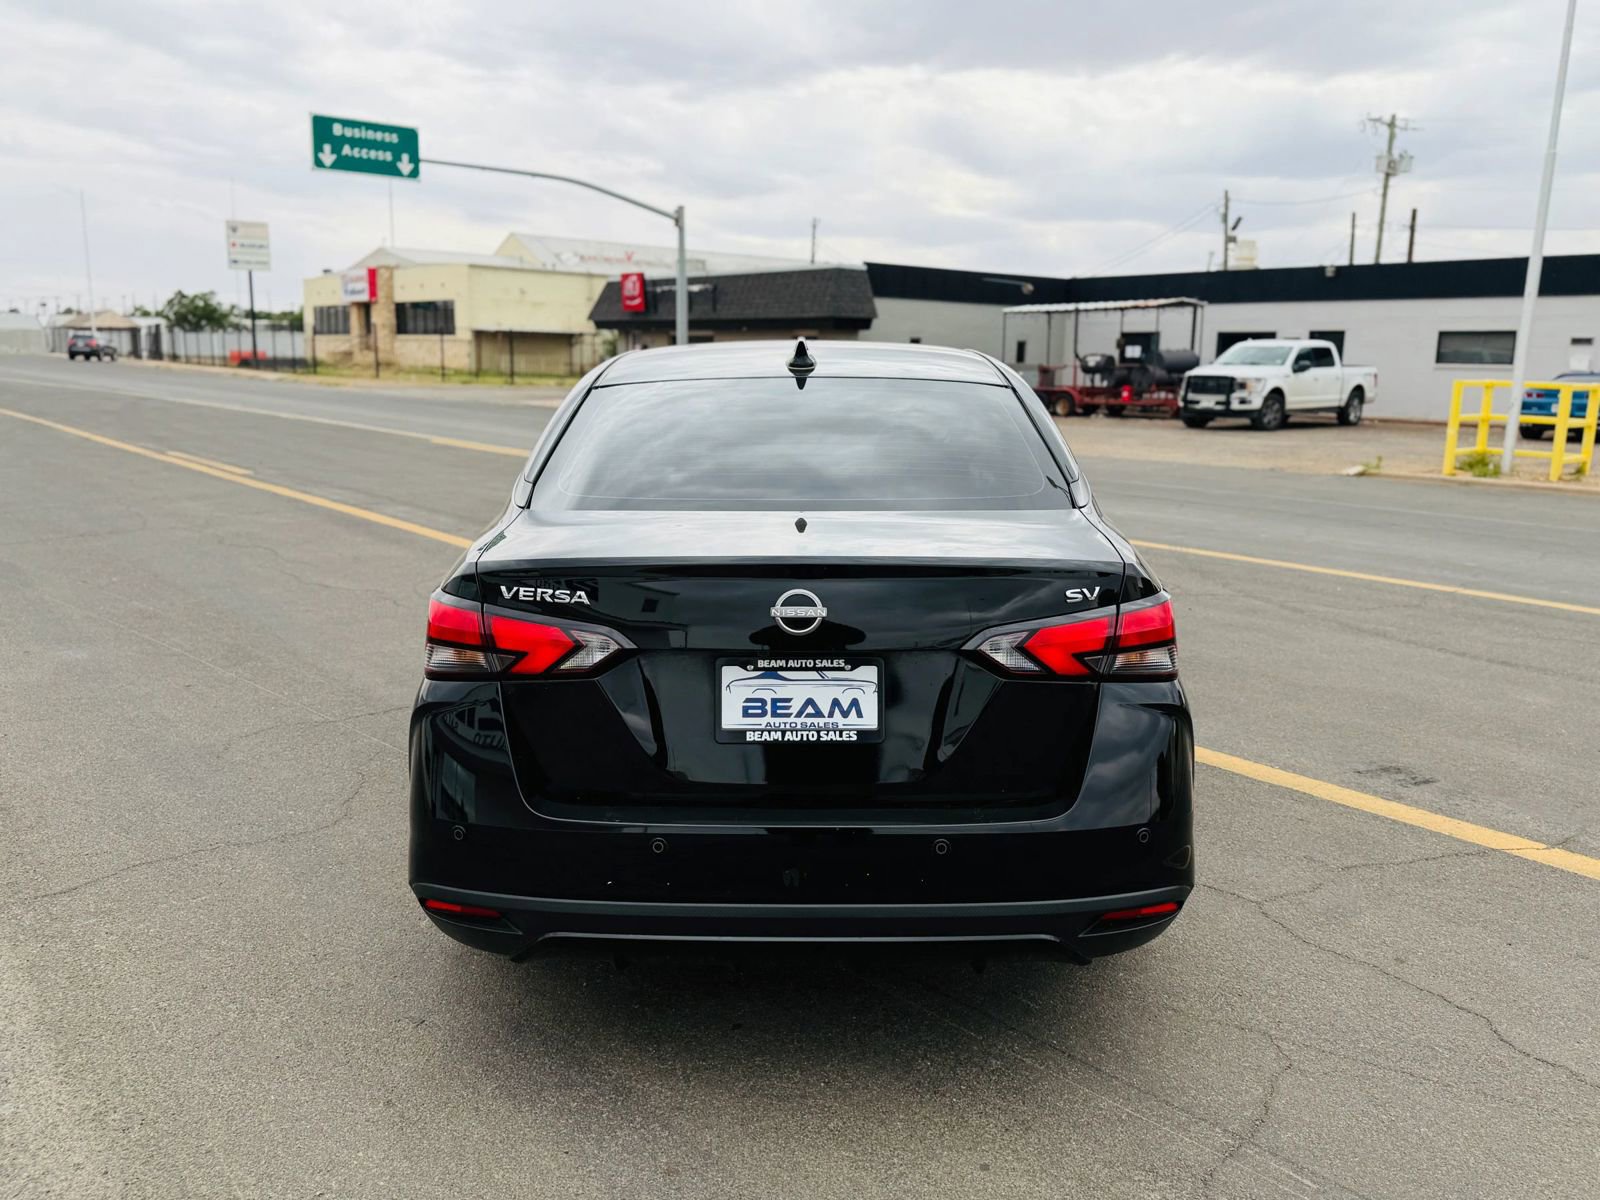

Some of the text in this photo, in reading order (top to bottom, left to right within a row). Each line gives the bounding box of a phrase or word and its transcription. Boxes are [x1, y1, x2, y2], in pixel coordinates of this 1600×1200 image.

[332, 122, 399, 144] Business
[341, 144, 393, 162] Access
[500, 585, 591, 605] VERSA
[1065, 586, 1101, 603] SV
[771, 608, 827, 617] NISSAN
[757, 659, 845, 668] BEAM AUTO SALES
[742, 697, 864, 719] BEAM
[764, 721, 839, 729] AUTO SALES
[746, 731, 858, 741] BEAM AUTO SALES
